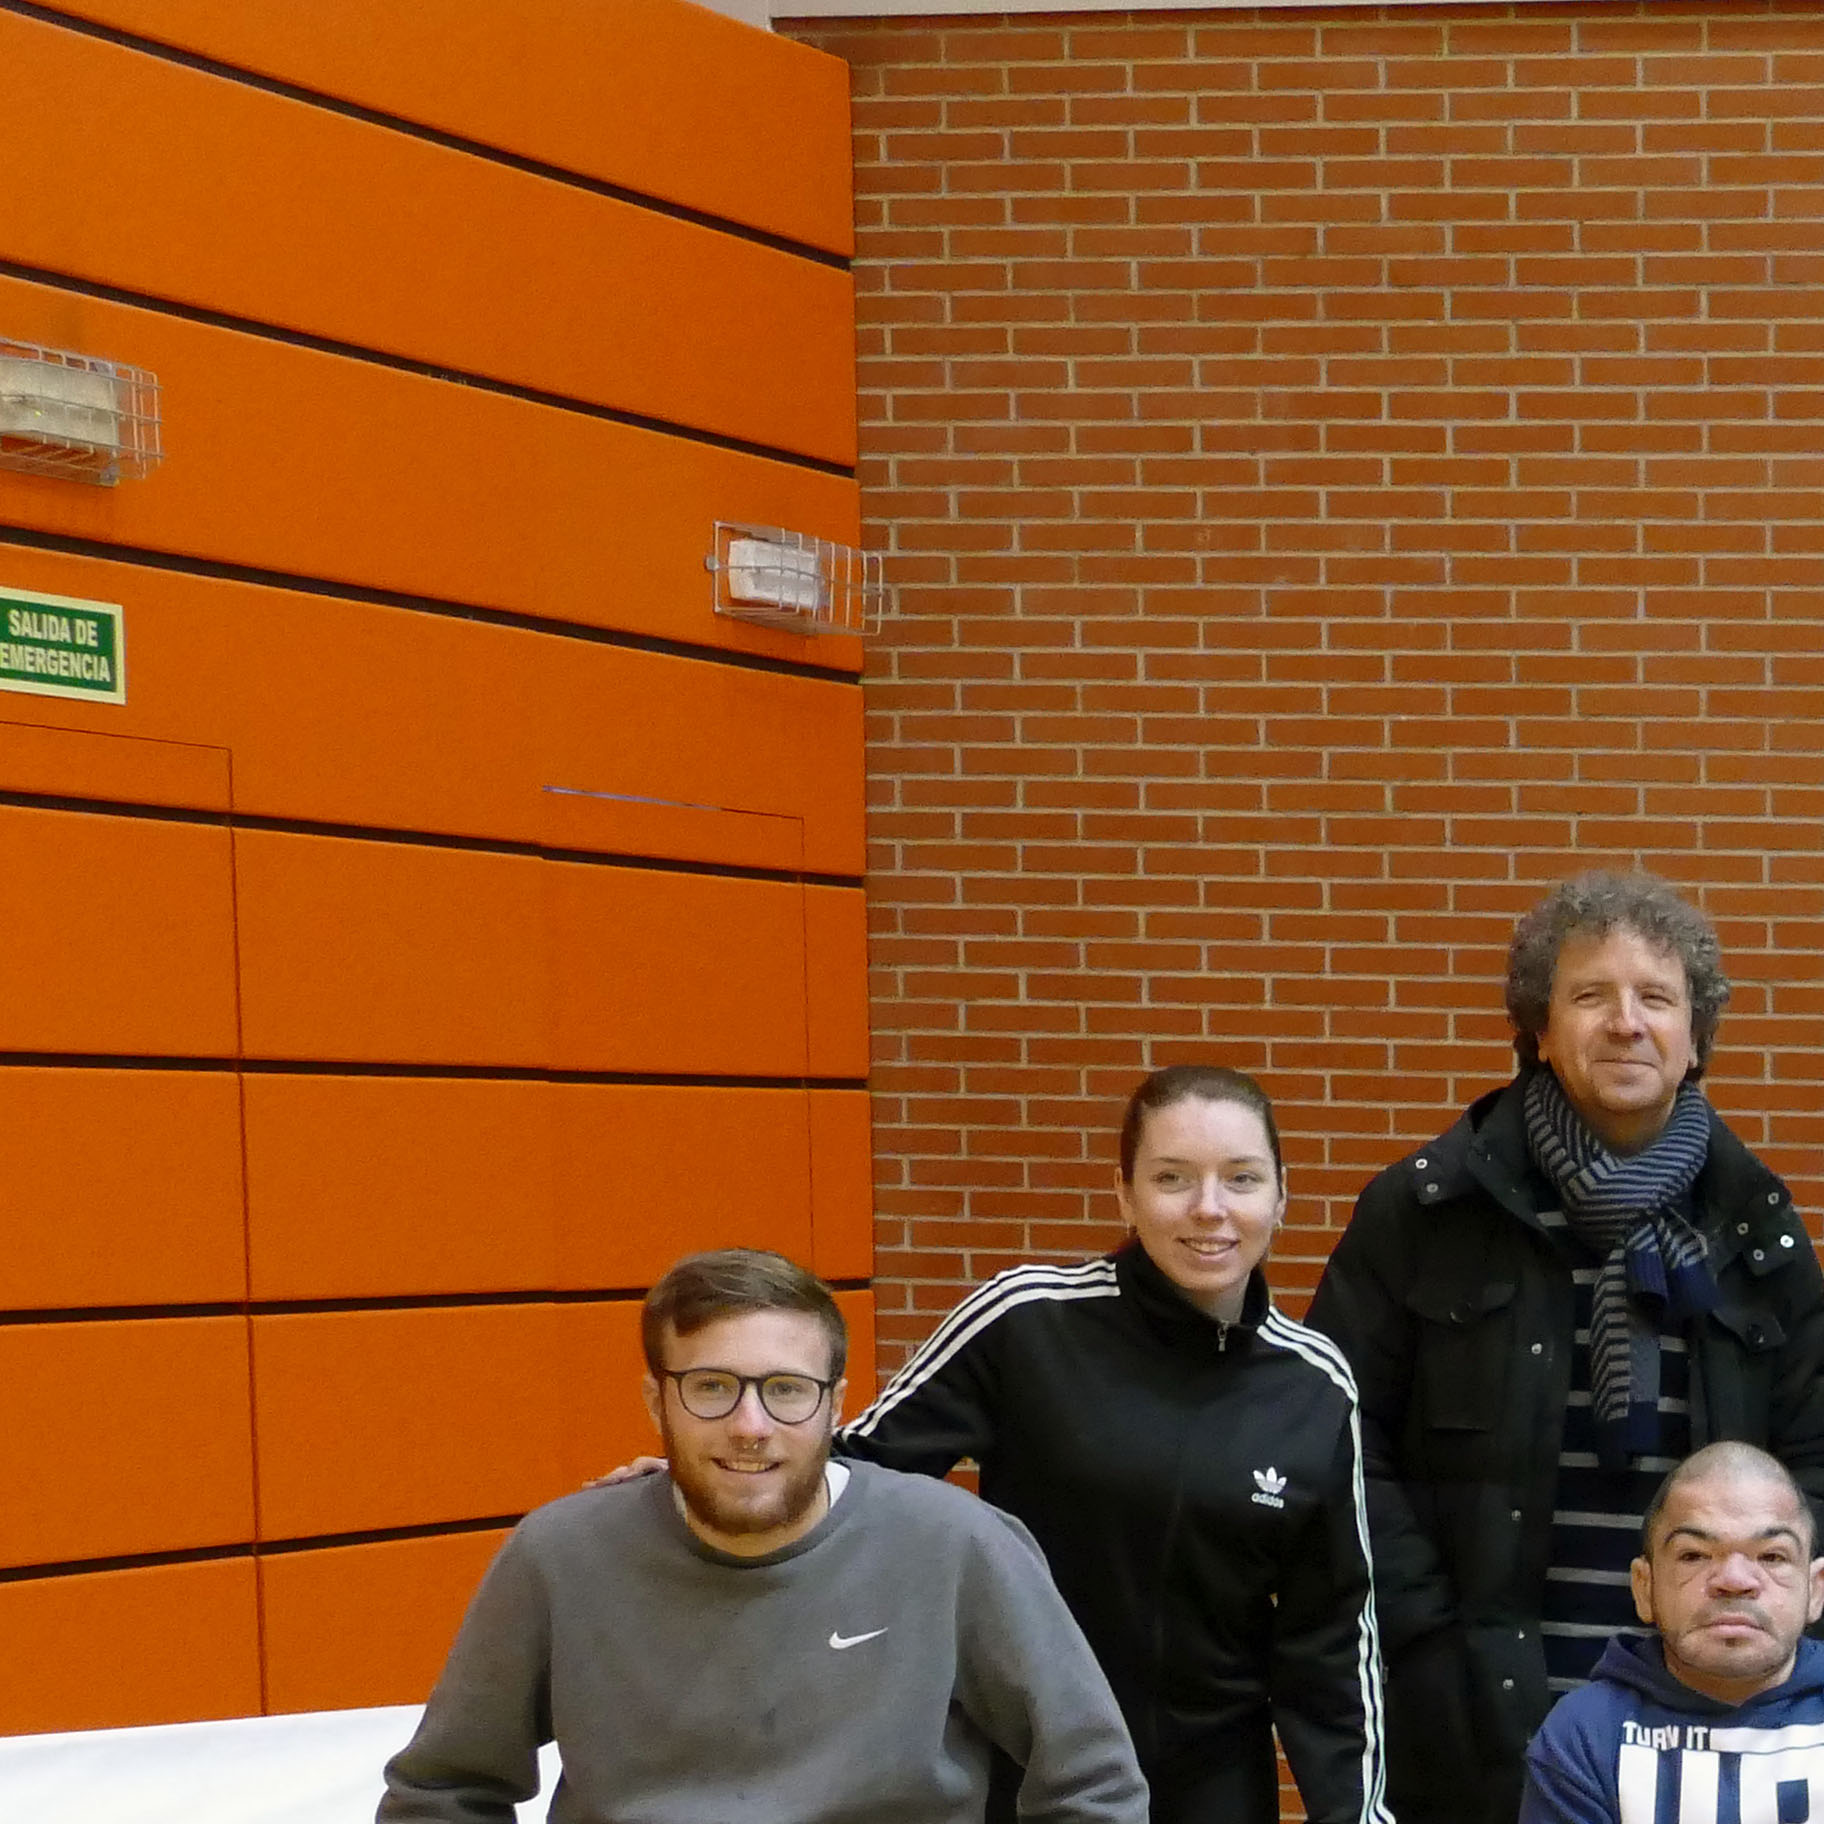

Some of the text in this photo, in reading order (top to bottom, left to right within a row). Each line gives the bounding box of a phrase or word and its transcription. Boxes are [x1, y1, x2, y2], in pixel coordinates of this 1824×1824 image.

[8, 609, 98, 647] SALIDA DE
[0, 641, 111, 682] EMERGENCIA
[1686, 1725, 1708, 1750] IT
